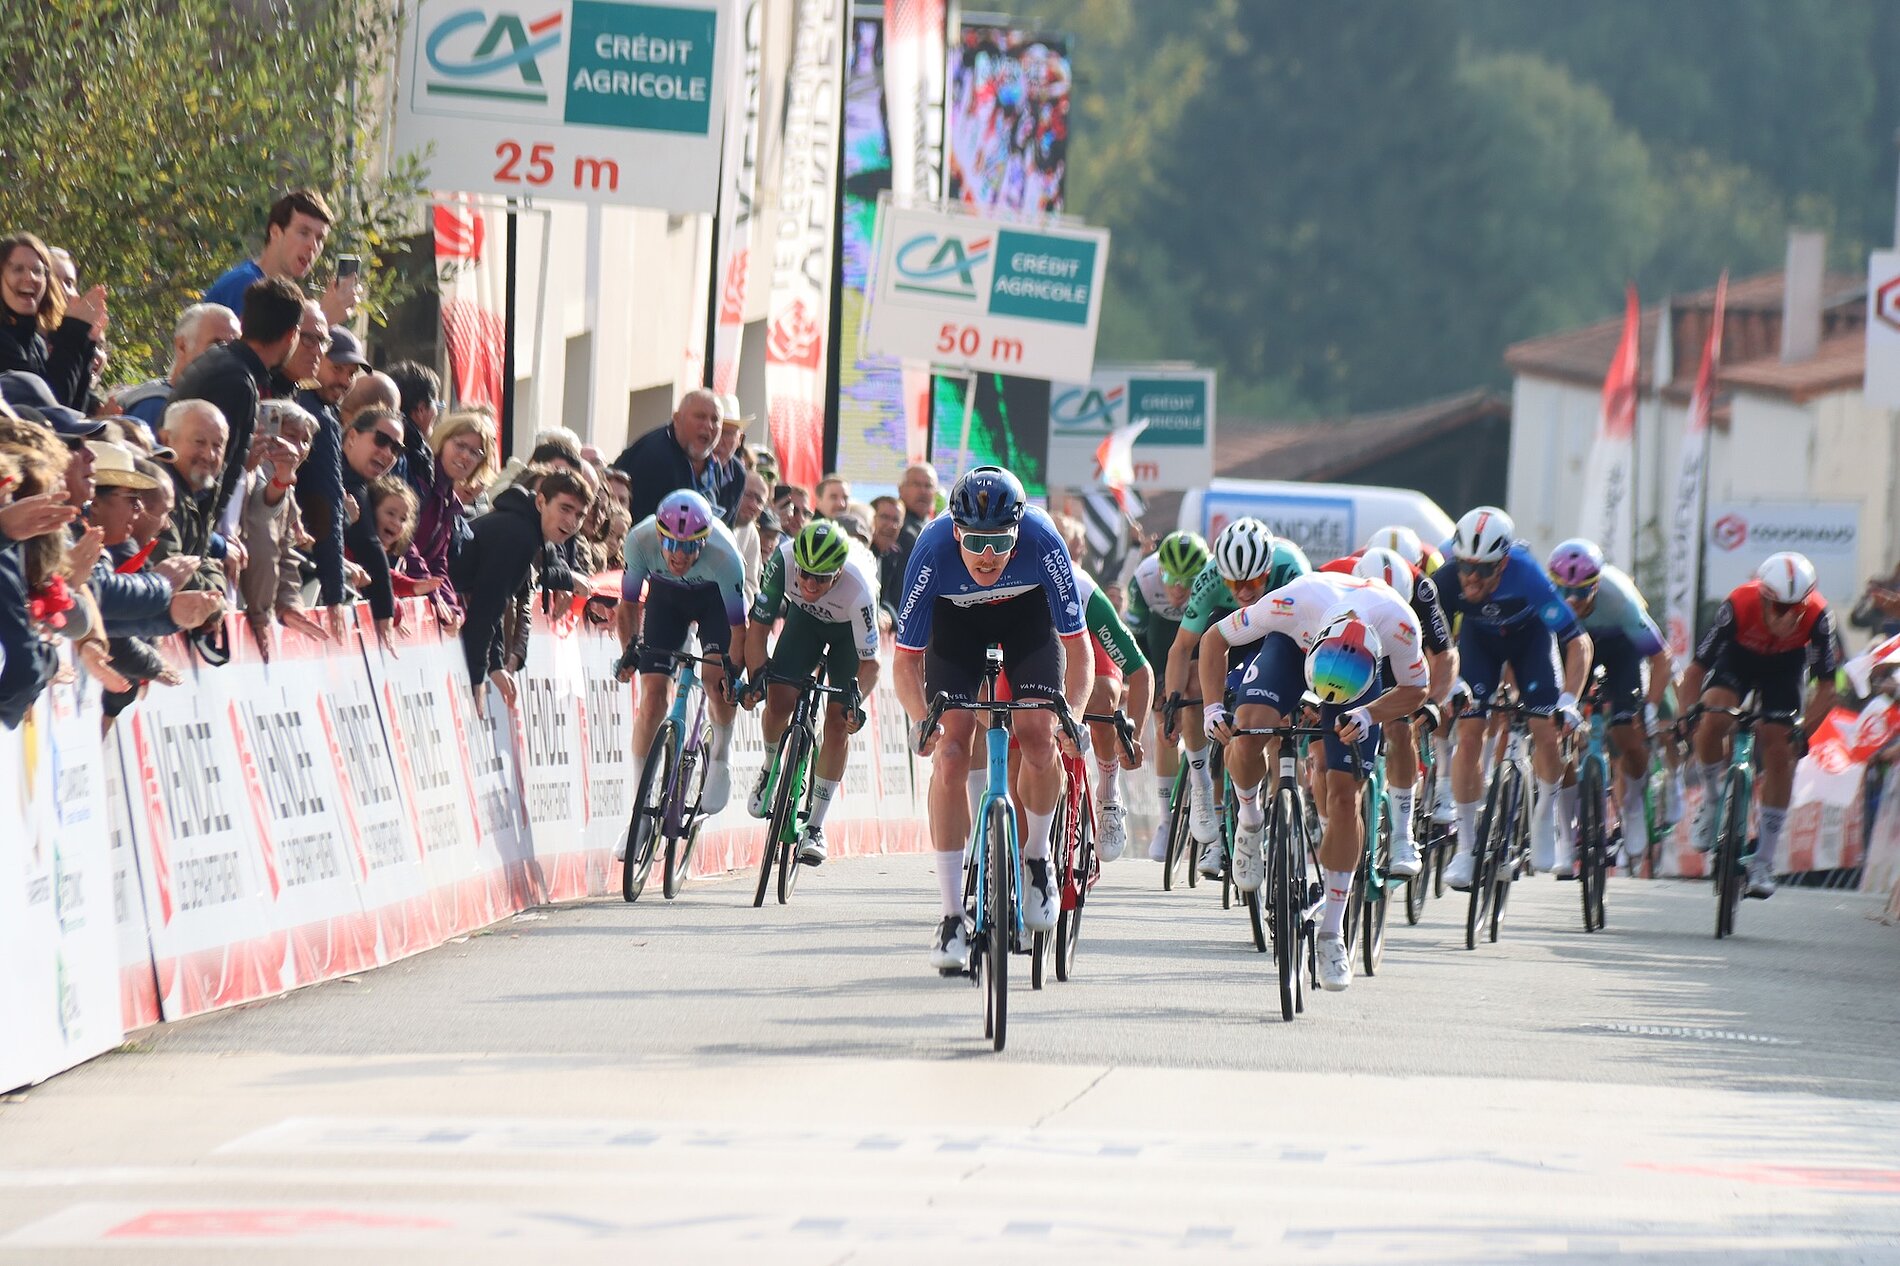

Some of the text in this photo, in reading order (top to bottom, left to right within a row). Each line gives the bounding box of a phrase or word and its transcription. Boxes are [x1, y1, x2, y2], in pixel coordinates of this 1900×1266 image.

[595, 31, 693, 67] CRÉDIT
[572, 67, 706, 102] AGRICOLE
[492, 139, 620, 192] 25 m
[1010, 250, 1081, 280] CRÉDIT
[993, 277, 1088, 305] AGRICOLE
[935, 323, 1024, 364] 50 m
[1133, 462, 1160, 482] m
[1042, 553, 1070, 602] MONDIALE
[1051, 548, 1074, 591] AG2R LA
[900, 565, 933, 620] DECATHLON
[1097, 624, 1128, 671] KOMETA
